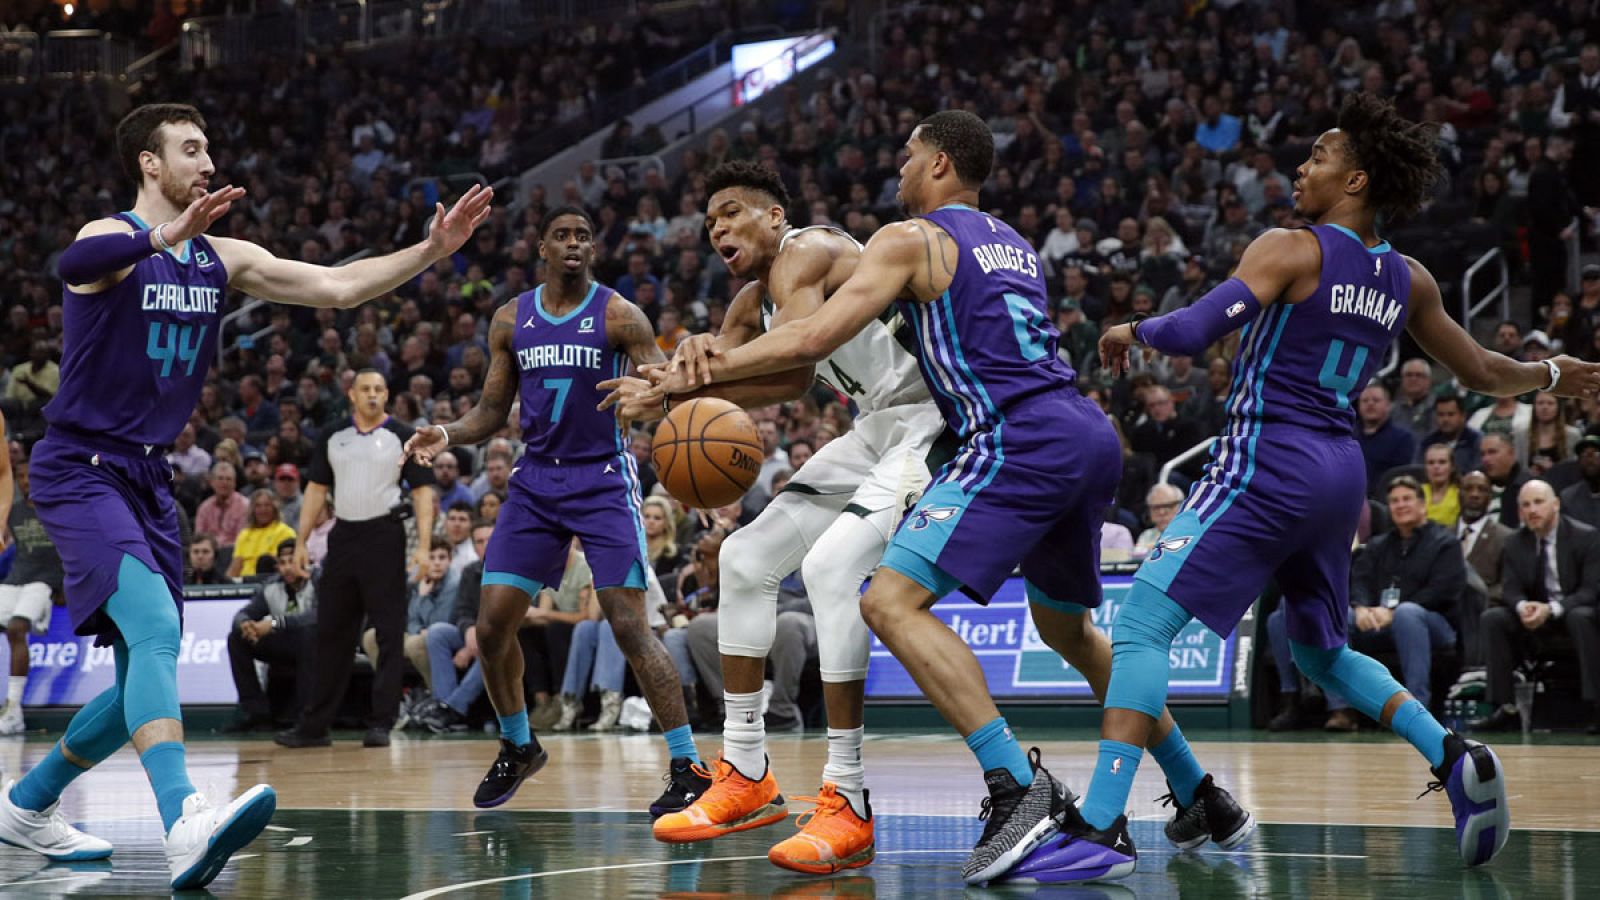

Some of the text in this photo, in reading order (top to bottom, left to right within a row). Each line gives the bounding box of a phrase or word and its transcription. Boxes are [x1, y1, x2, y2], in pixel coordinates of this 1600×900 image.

[972, 243, 1038, 279] BRIDGES
[1003, 292, 1050, 363] 0
[1330, 284, 1403, 331] GRAHAM
[146, 322, 208, 377] 44
[517, 344, 602, 370] CHARLOTTE
[1319, 339, 1369, 410] 4
[543, 378, 573, 423] 7
